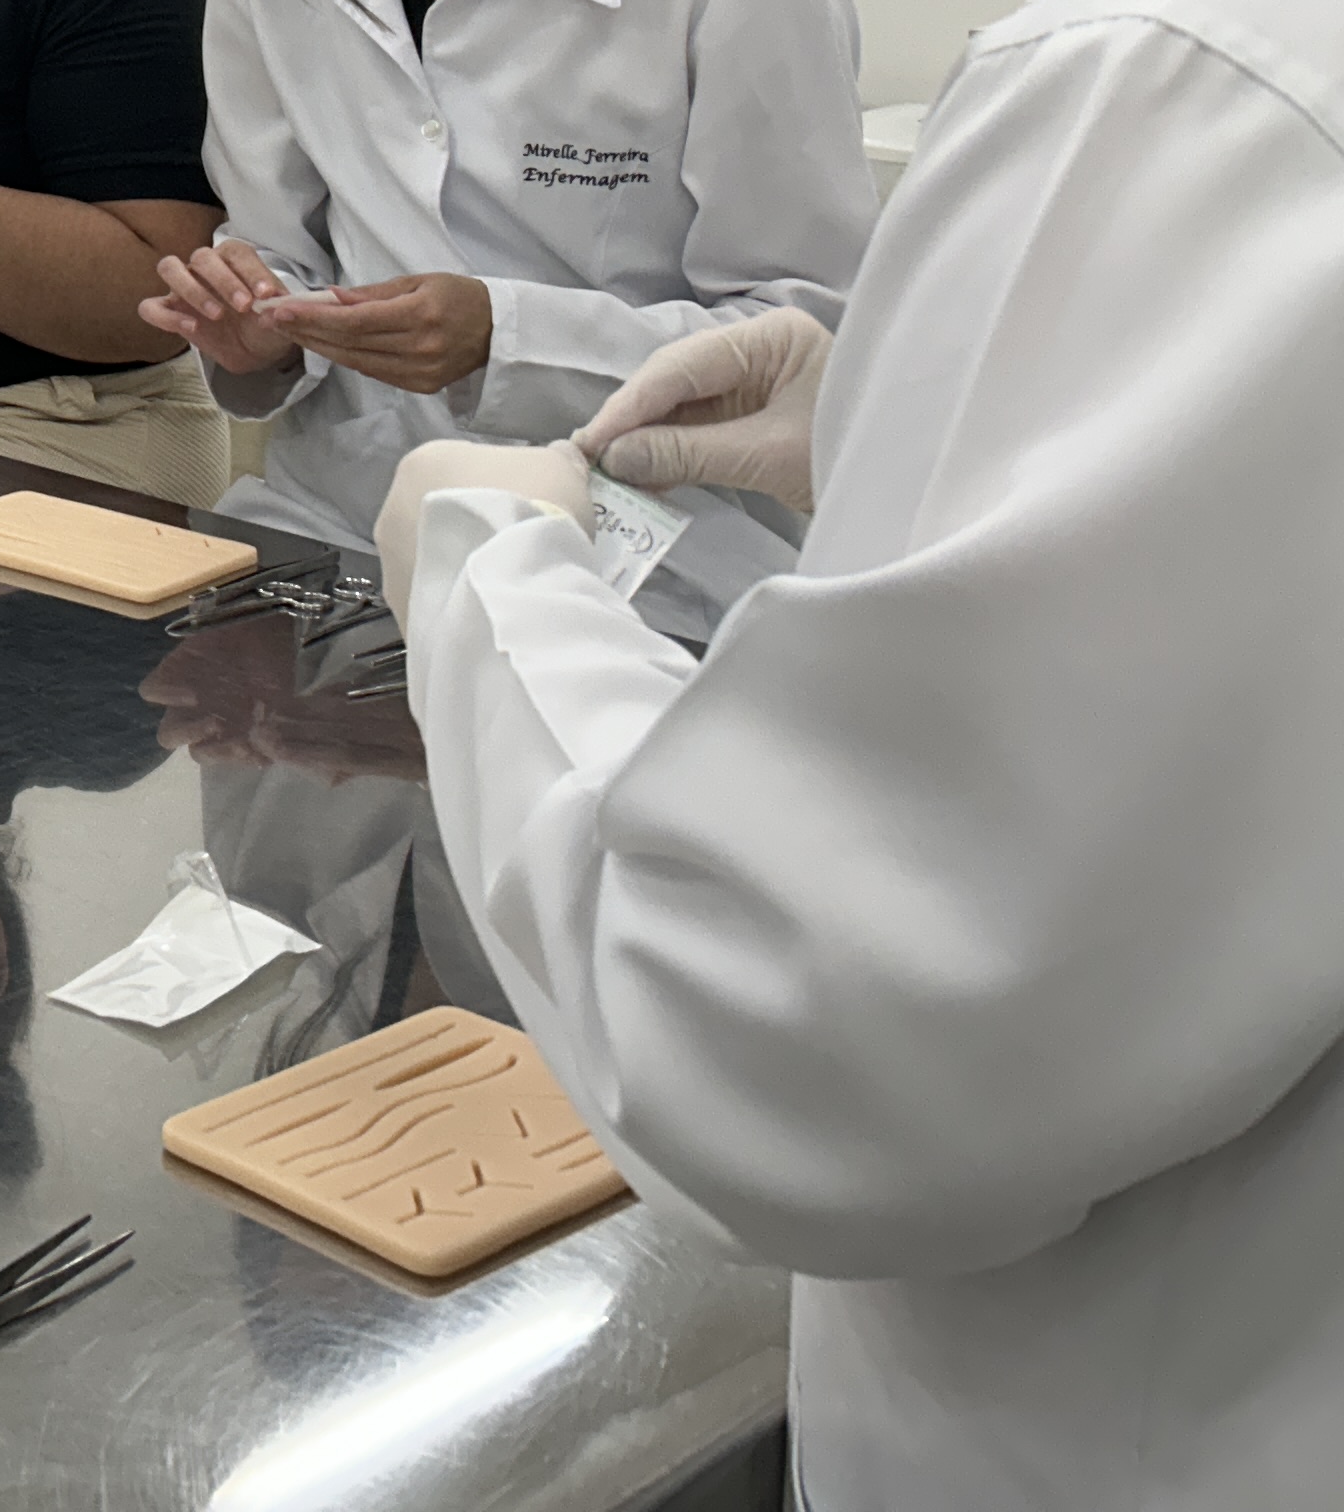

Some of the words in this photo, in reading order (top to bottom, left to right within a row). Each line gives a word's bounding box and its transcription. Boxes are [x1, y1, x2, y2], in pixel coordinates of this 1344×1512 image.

[523, 143, 578, 160] Mirelle
[580, 148, 649, 165] Ferreira
[522, 167, 650, 190] Enfermagem
